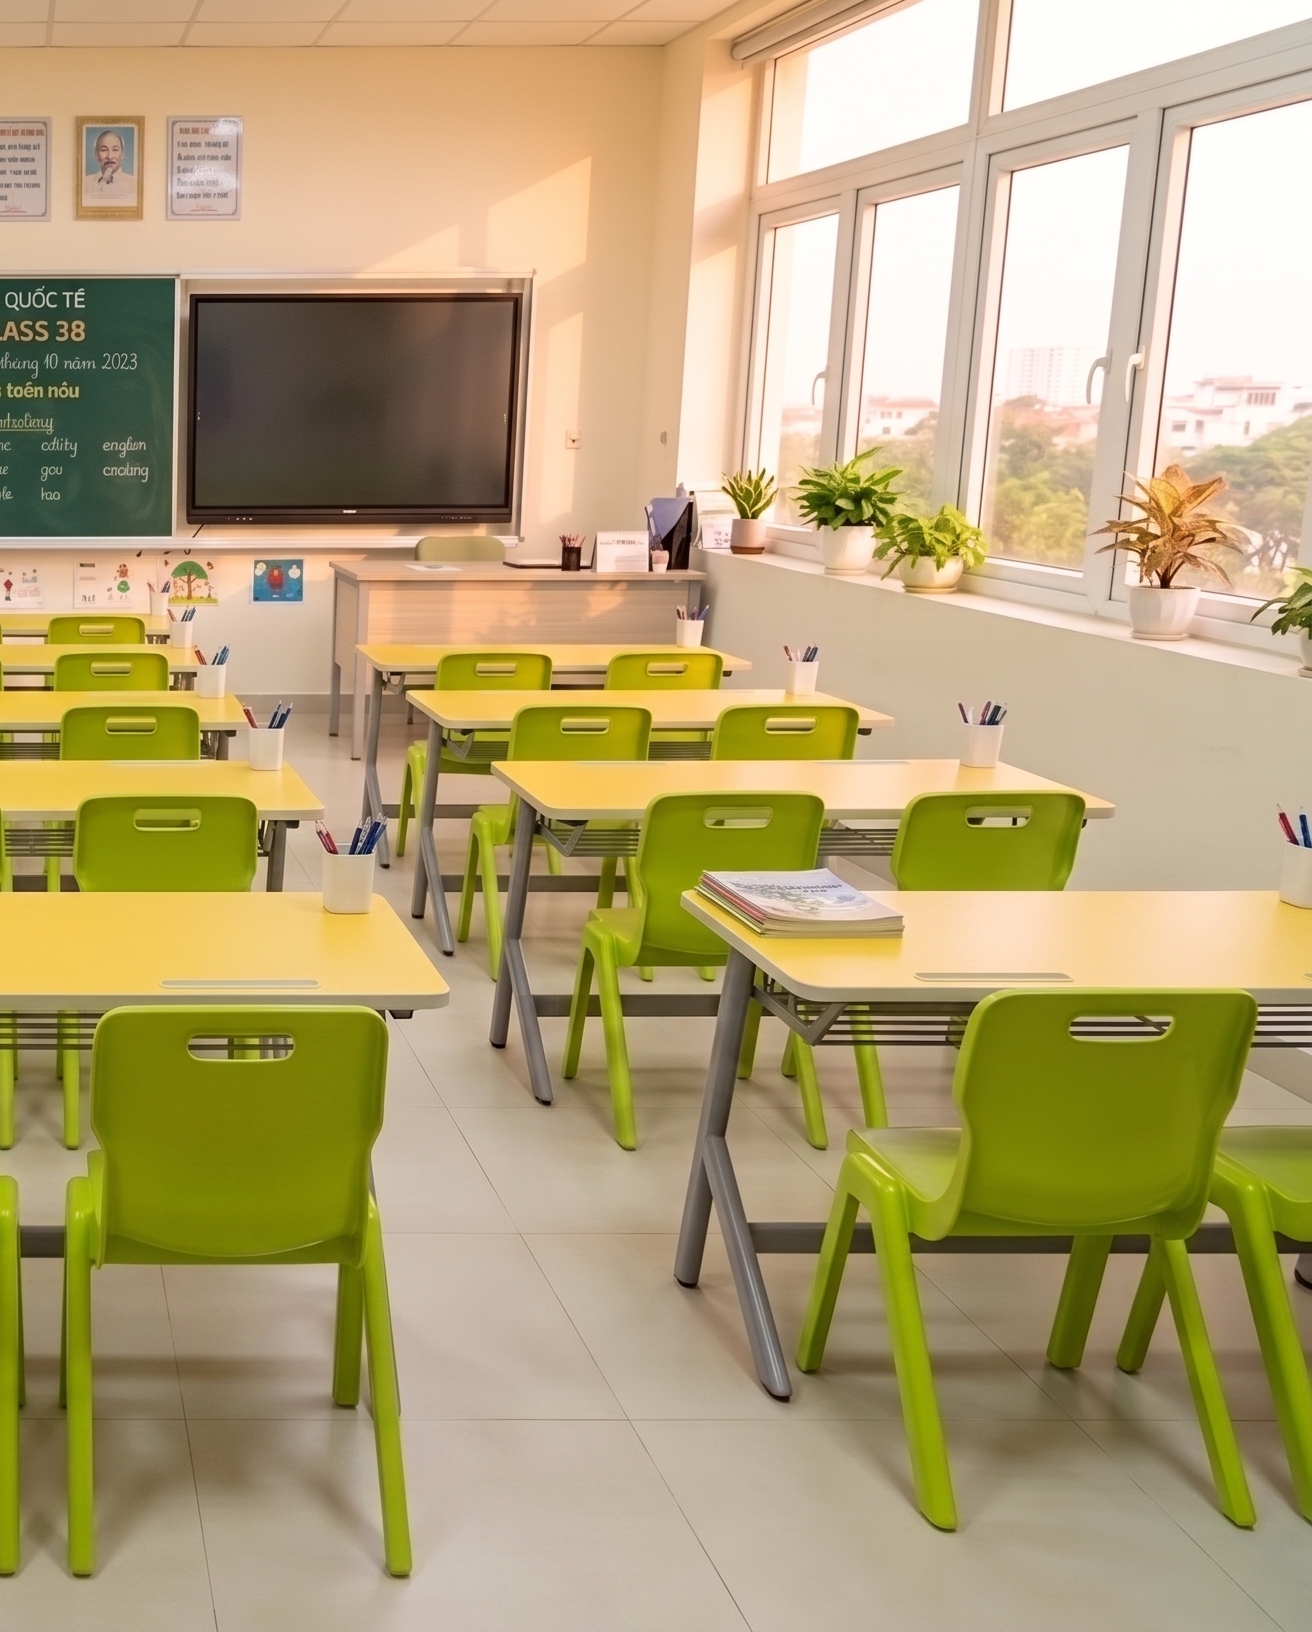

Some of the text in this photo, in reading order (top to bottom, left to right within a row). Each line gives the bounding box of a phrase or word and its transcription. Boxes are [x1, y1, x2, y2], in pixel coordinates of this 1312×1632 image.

[55, 320, 86, 342] 38
[43, 353, 59, 370] 10
[101, 352, 139, 370] 2023
